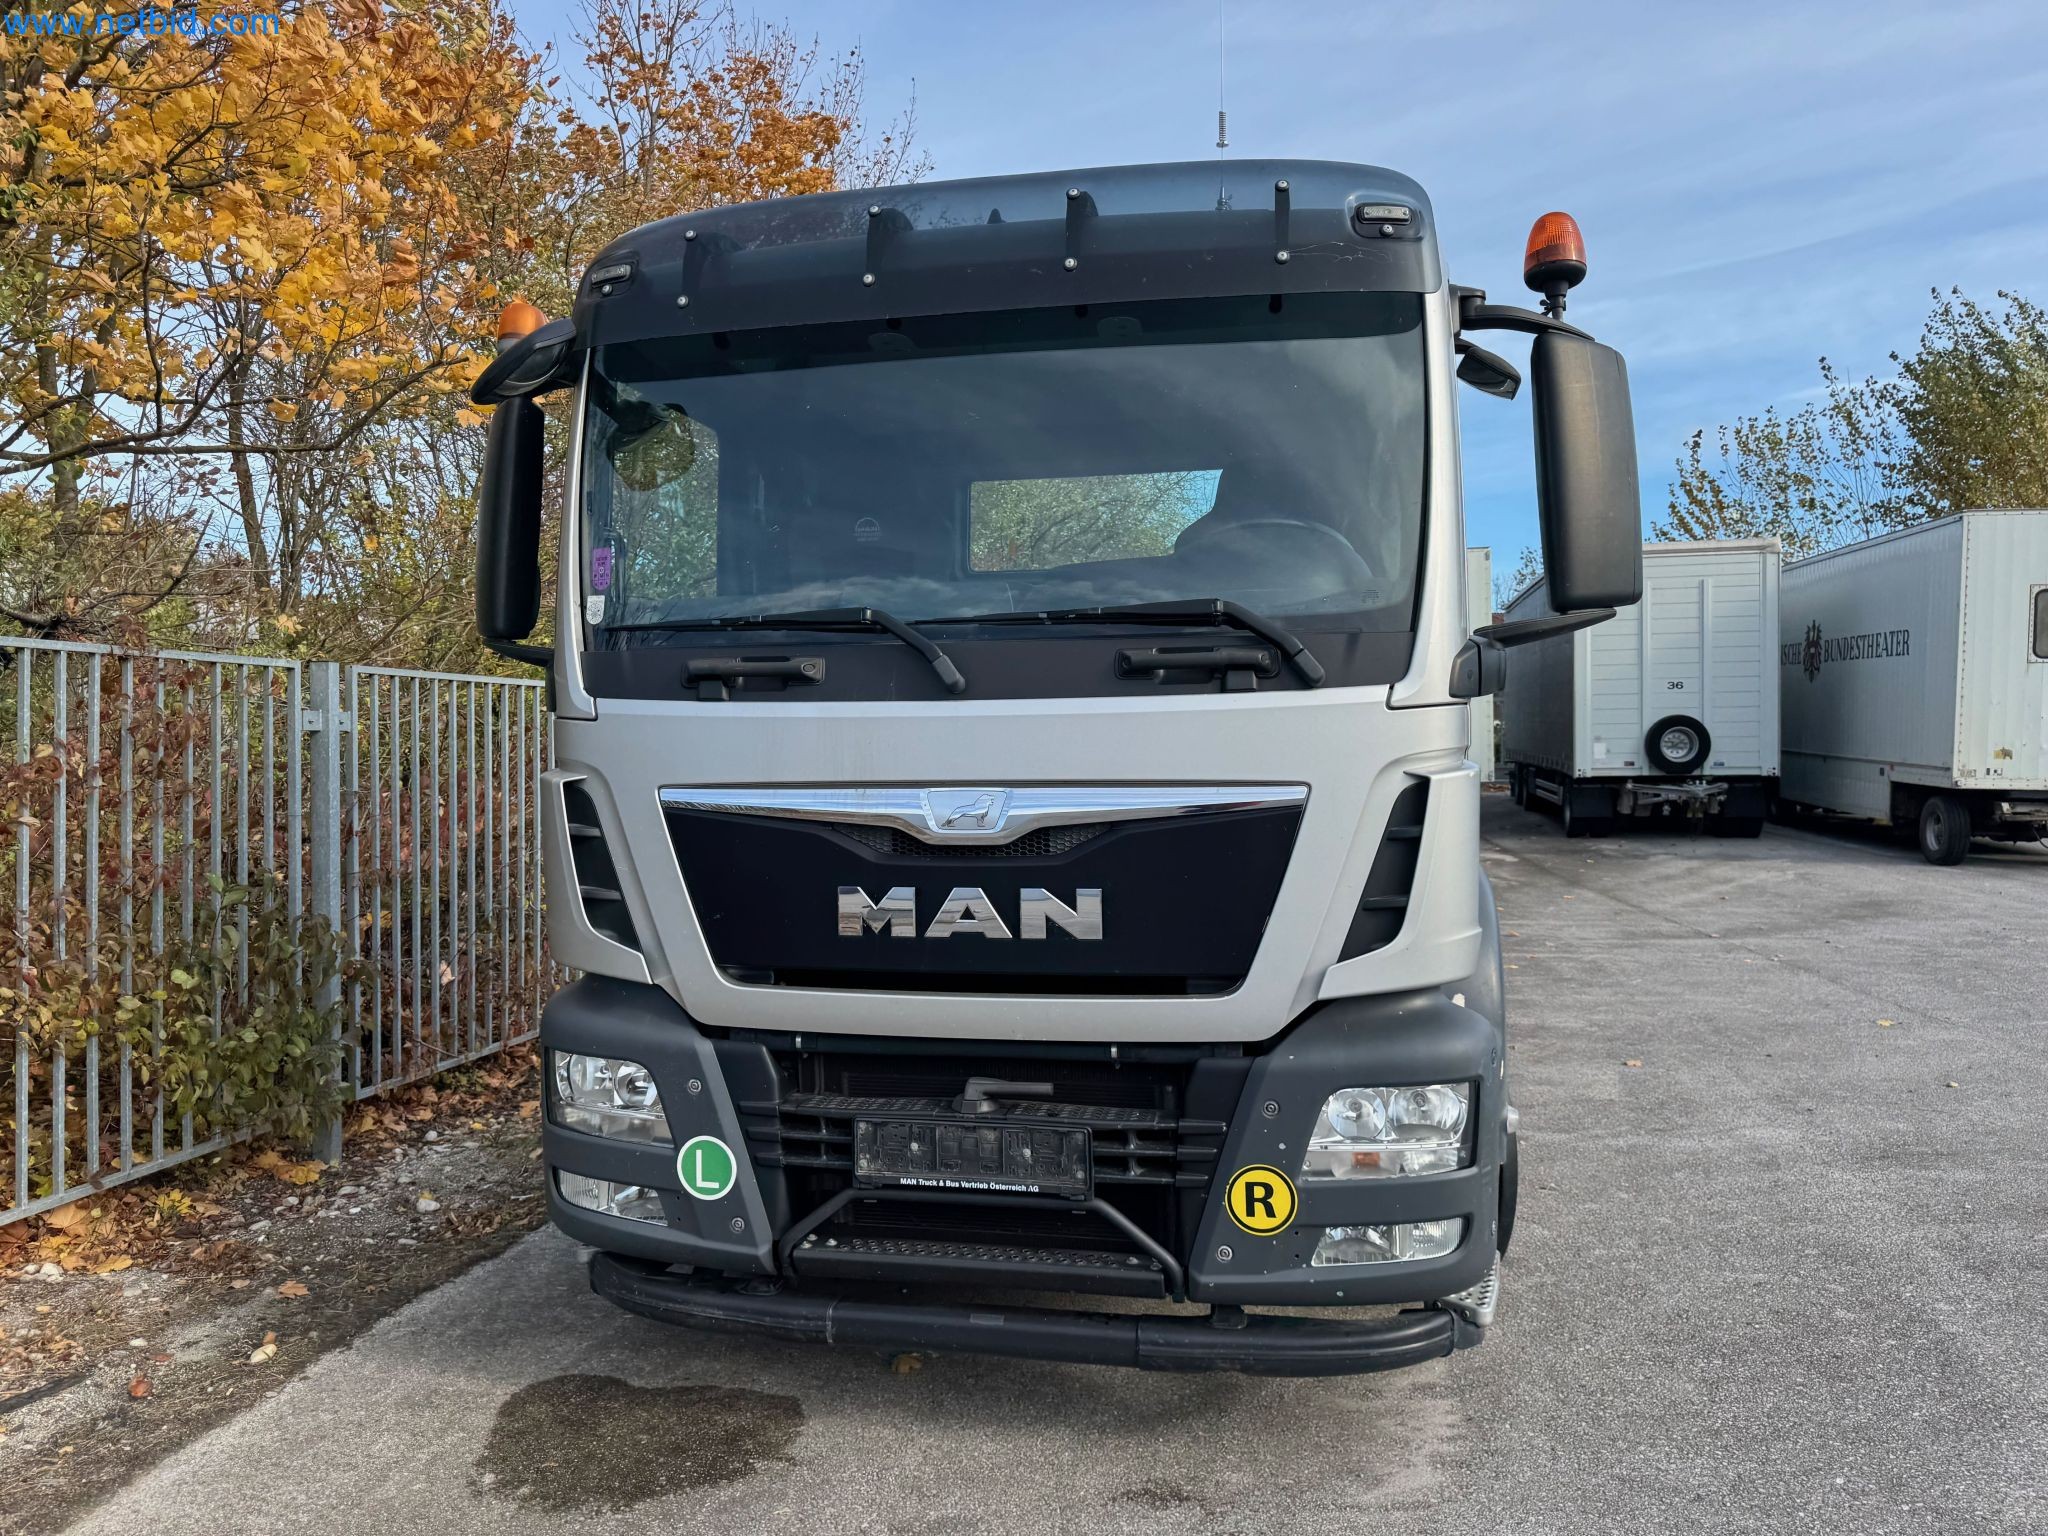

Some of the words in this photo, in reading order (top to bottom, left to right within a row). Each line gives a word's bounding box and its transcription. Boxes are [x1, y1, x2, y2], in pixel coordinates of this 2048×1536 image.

[1824, 629, 1910, 662] BUNDESTHEATER
[1667, 681, 1684, 690] 36
[838, 886, 1103, 940] MAN
[696, 1149, 720, 1189] L
[918, 1178, 938, 1187] Truck
[939, 1179, 944, 1187] &
[945, 1180, 960, 1188] Bus
[1245, 1182, 1277, 1218] R
